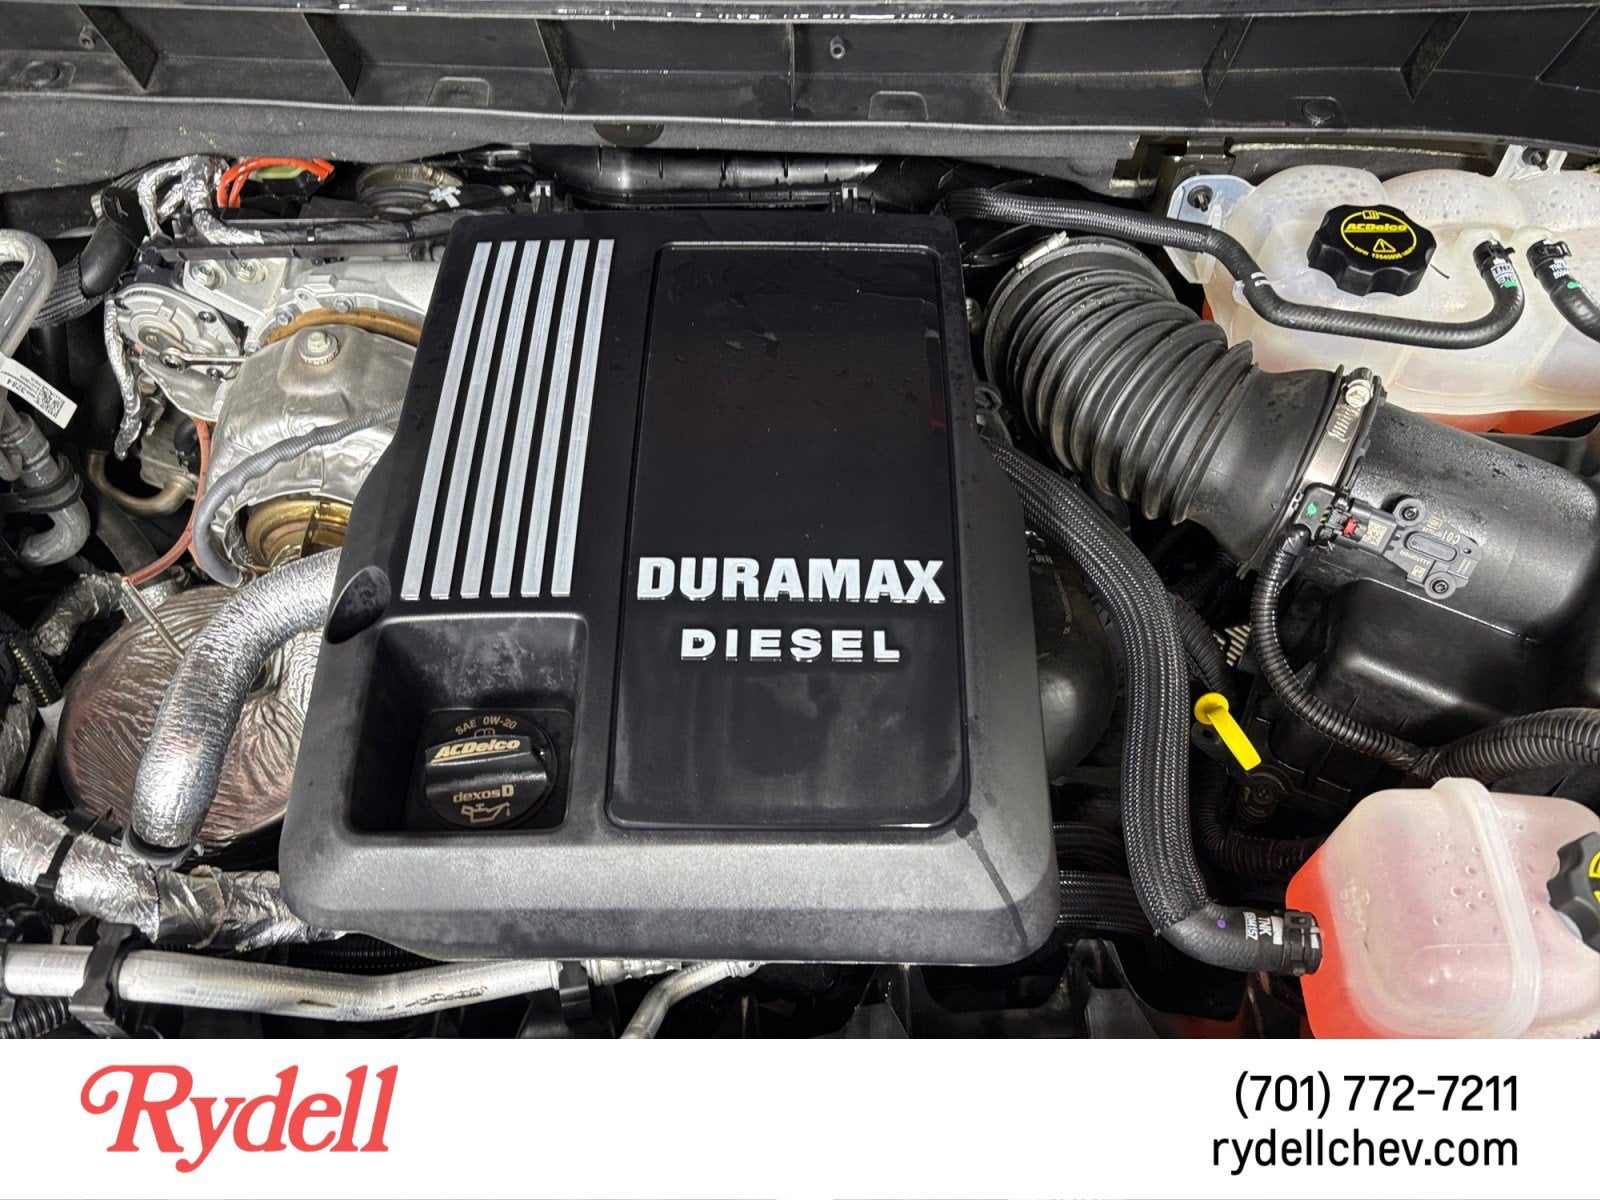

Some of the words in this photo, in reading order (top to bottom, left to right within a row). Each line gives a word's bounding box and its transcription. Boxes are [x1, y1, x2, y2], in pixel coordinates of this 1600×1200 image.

[1344, 223, 1408, 233] ACDelco
[637, 557, 945, 603] DURAMAX
[681, 628, 900, 662] DIESEL
[455, 719, 477, 736] SAE
[483, 716, 518, 730] 0W-20
[430, 738, 521, 764] ACDelco
[1258, 917, 1272, 936] TNK
